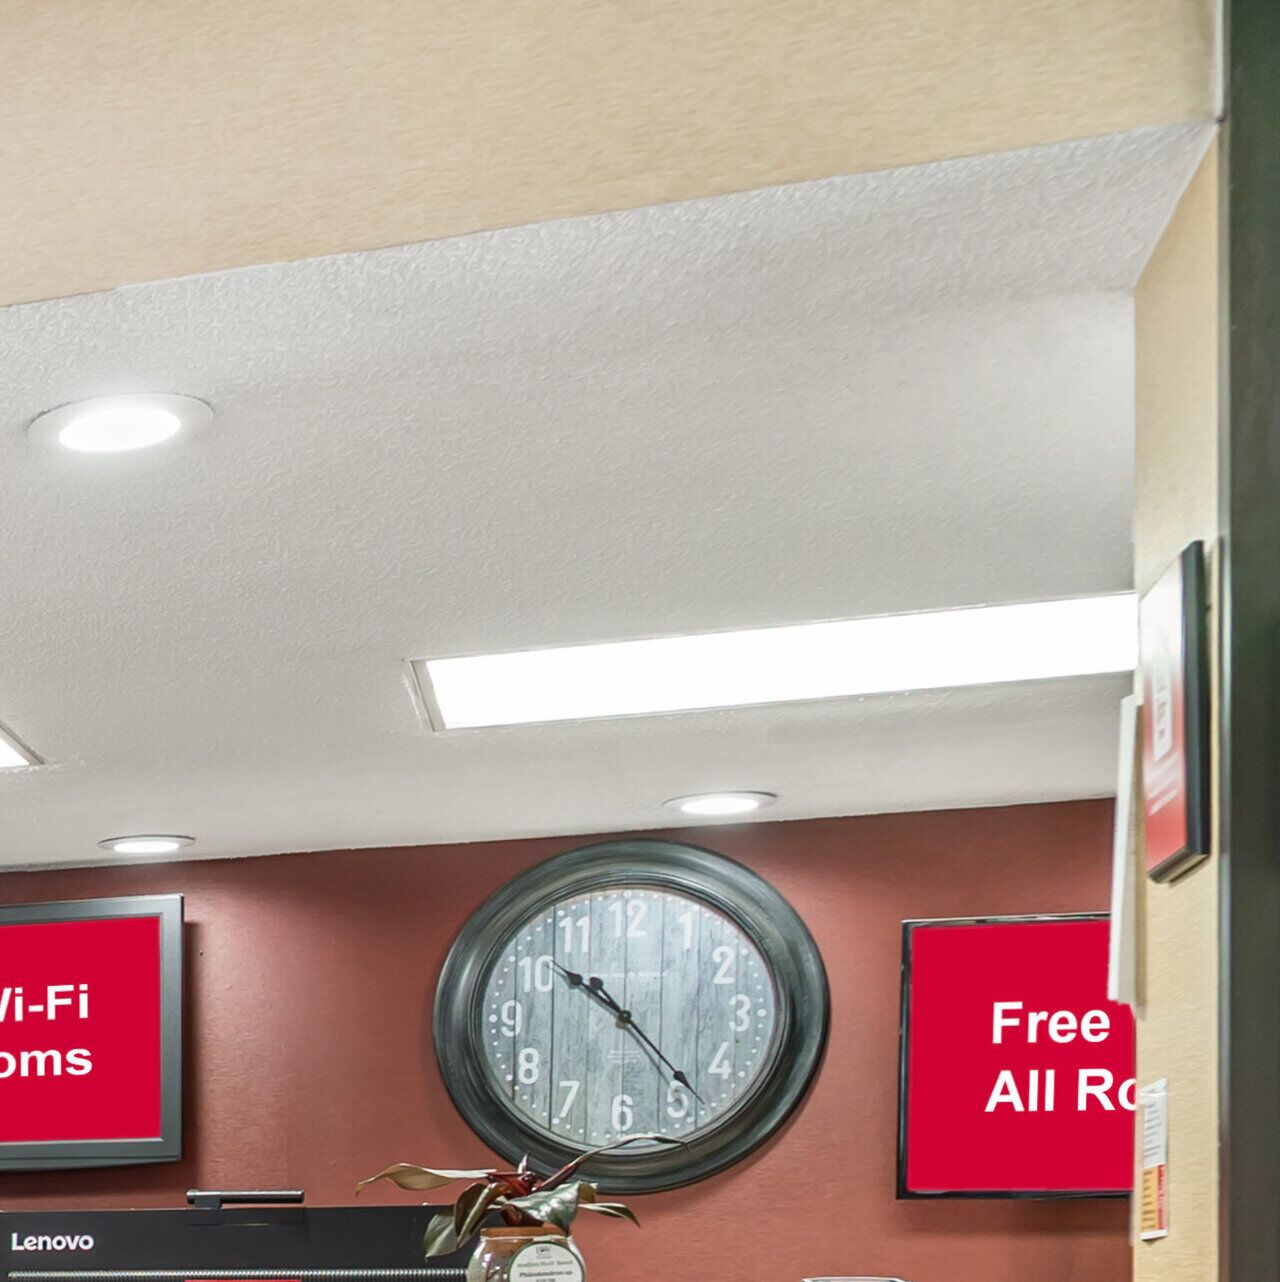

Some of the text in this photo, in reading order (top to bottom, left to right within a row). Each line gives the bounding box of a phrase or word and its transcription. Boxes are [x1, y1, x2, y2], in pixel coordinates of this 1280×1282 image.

[559, 916, 591, 954] 11
[609, 900, 648, 938] 12
[678, 911, 694, 950] 1
[518, 955, 554, 993] 10
[712, 945, 736, 985] 2
[500, 1000, 523, 1037] 9
[728, 994, 752, 1032] 3
[992, 1001, 1111, 1044] Free
[518, 1047, 540, 1085] 8
[707, 1041, 732, 1080] 4
[559, 1080, 581, 1118] 7
[666, 1080, 689, 1118] 5
[984, 1069, 1056, 1113] All
[611, 1094, 634, 1132] 6
[11, 1232, 95, 1251] Lenovo
